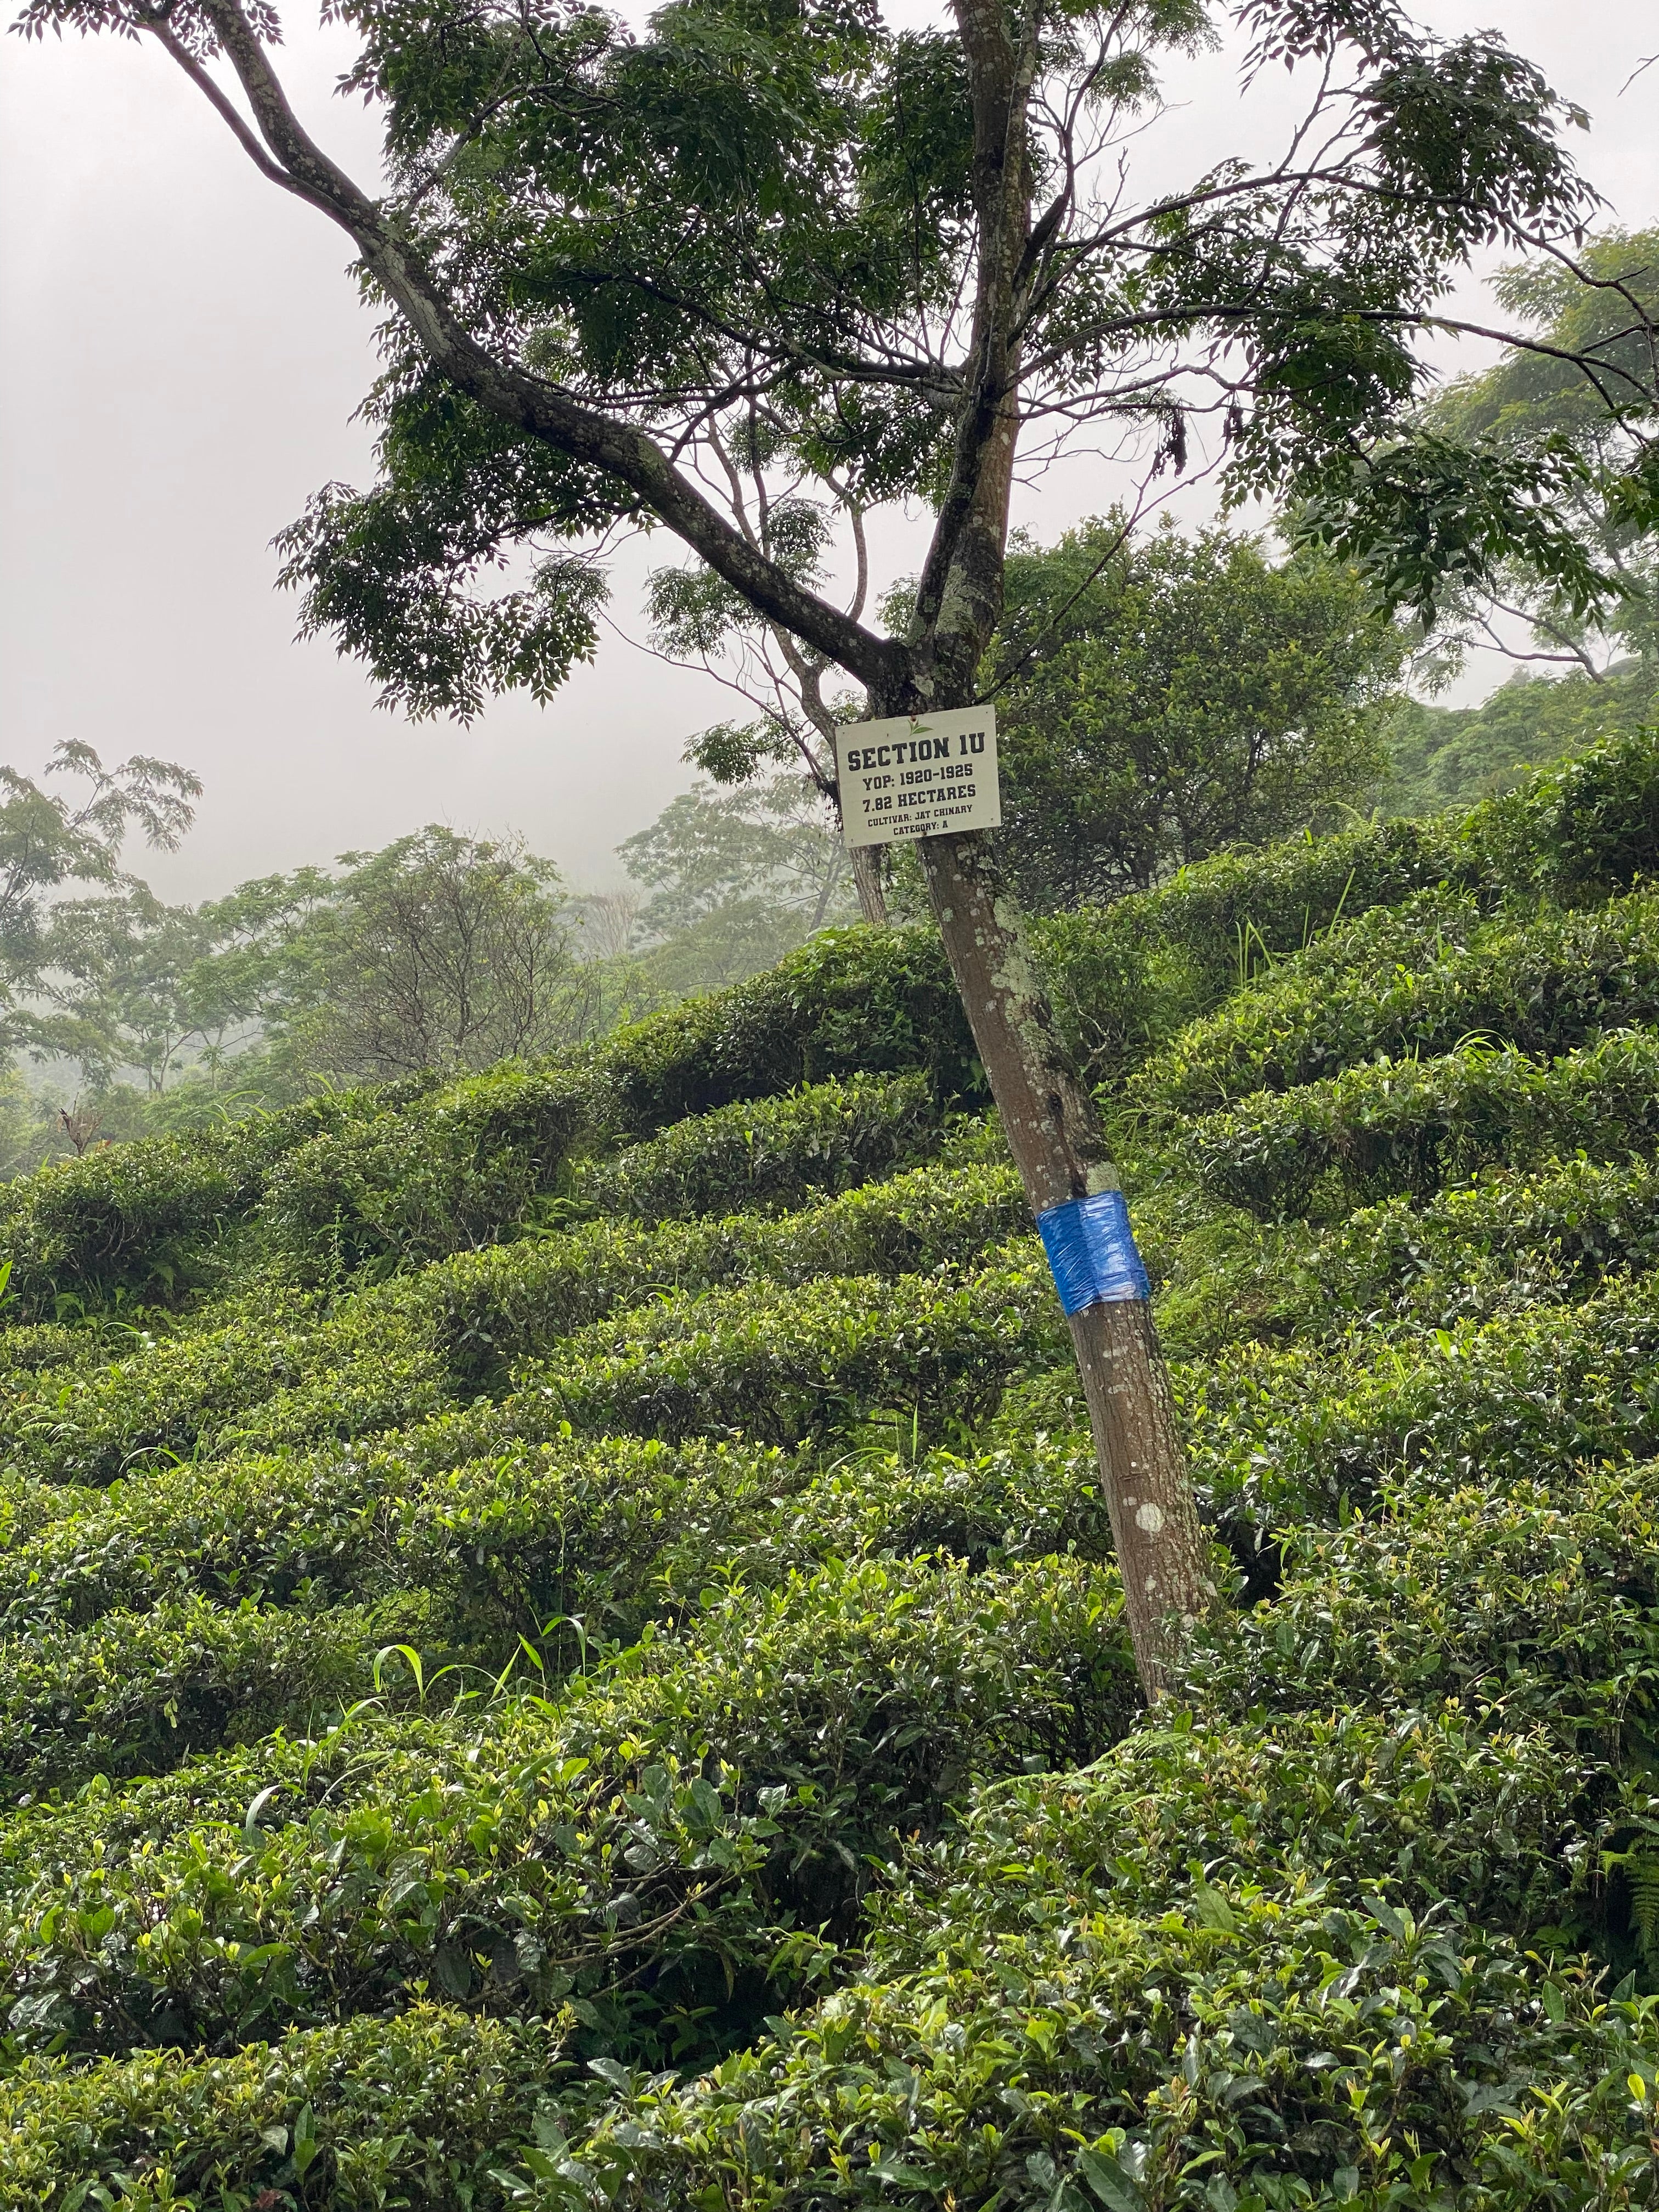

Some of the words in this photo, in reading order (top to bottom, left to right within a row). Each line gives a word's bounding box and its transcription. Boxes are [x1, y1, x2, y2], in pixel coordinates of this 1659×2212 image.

[848, 737, 949, 771] SECTION
[960, 732, 985, 755] 1U
[862, 775, 895, 791] YOP:
[900, 763, 973, 786] 1920-1925
[863, 796, 892, 812] 7.82
[898, 784, 976, 807] HECTARES
[868, 814, 912, 827] CULTIVAR:
[915, 811, 930, 820] JAT
[934, 805, 972, 817] CHINARY
[893, 822, 939, 835] CATEGORY:
